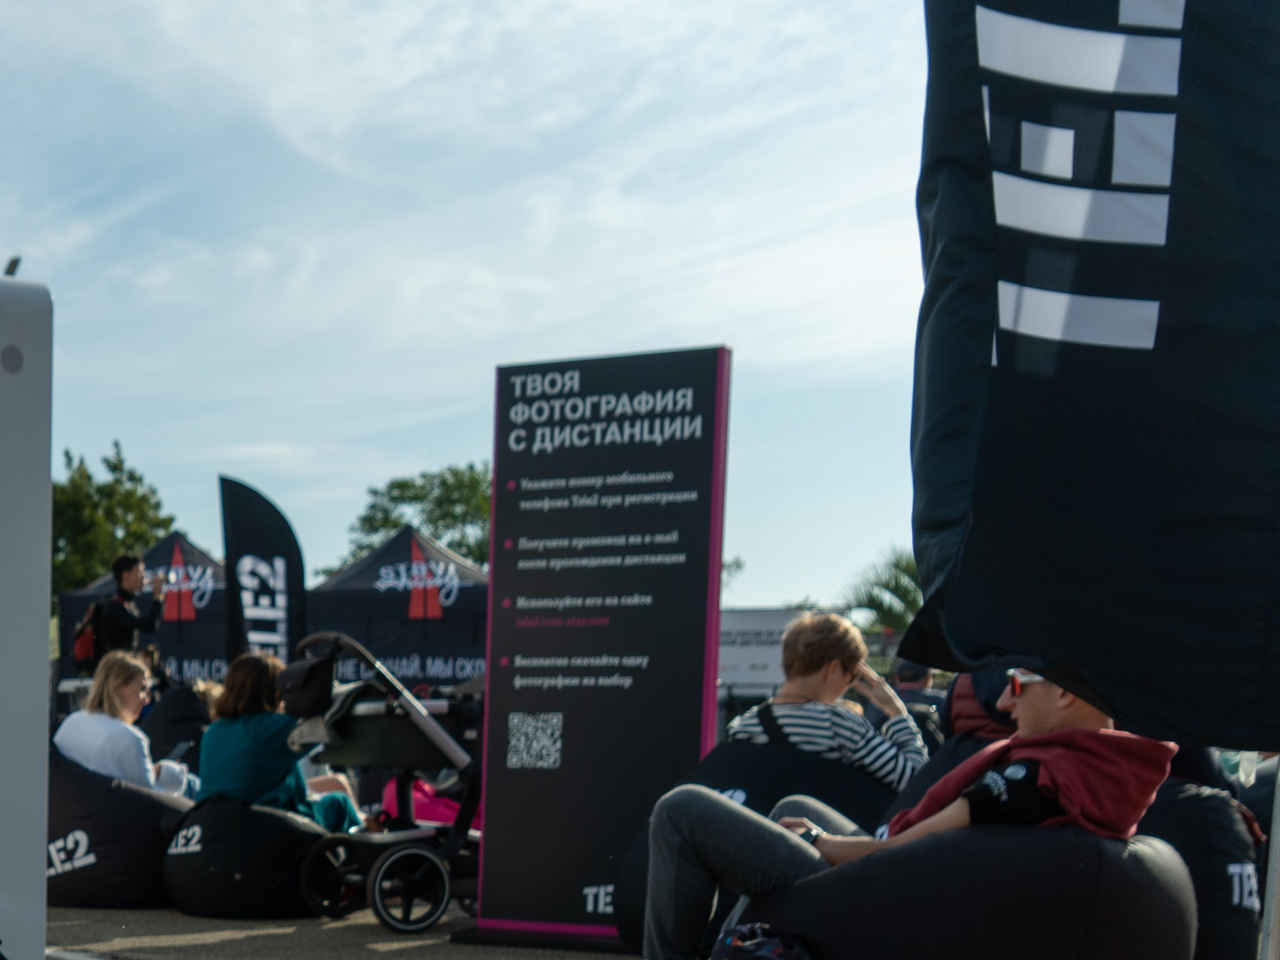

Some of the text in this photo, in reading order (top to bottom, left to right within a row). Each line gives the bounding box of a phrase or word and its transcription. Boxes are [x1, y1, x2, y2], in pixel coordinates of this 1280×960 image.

[510, 370, 581, 398] ТВОЯ
[509, 387, 694, 425] ФОТОГРАФИЯ
[508, 414, 703, 455] С ДИСТАНЦИИ
[236, 555, 288, 665] ELE2
[455, 657, 486, 679] СКО
[583, 884, 614, 914] TE
